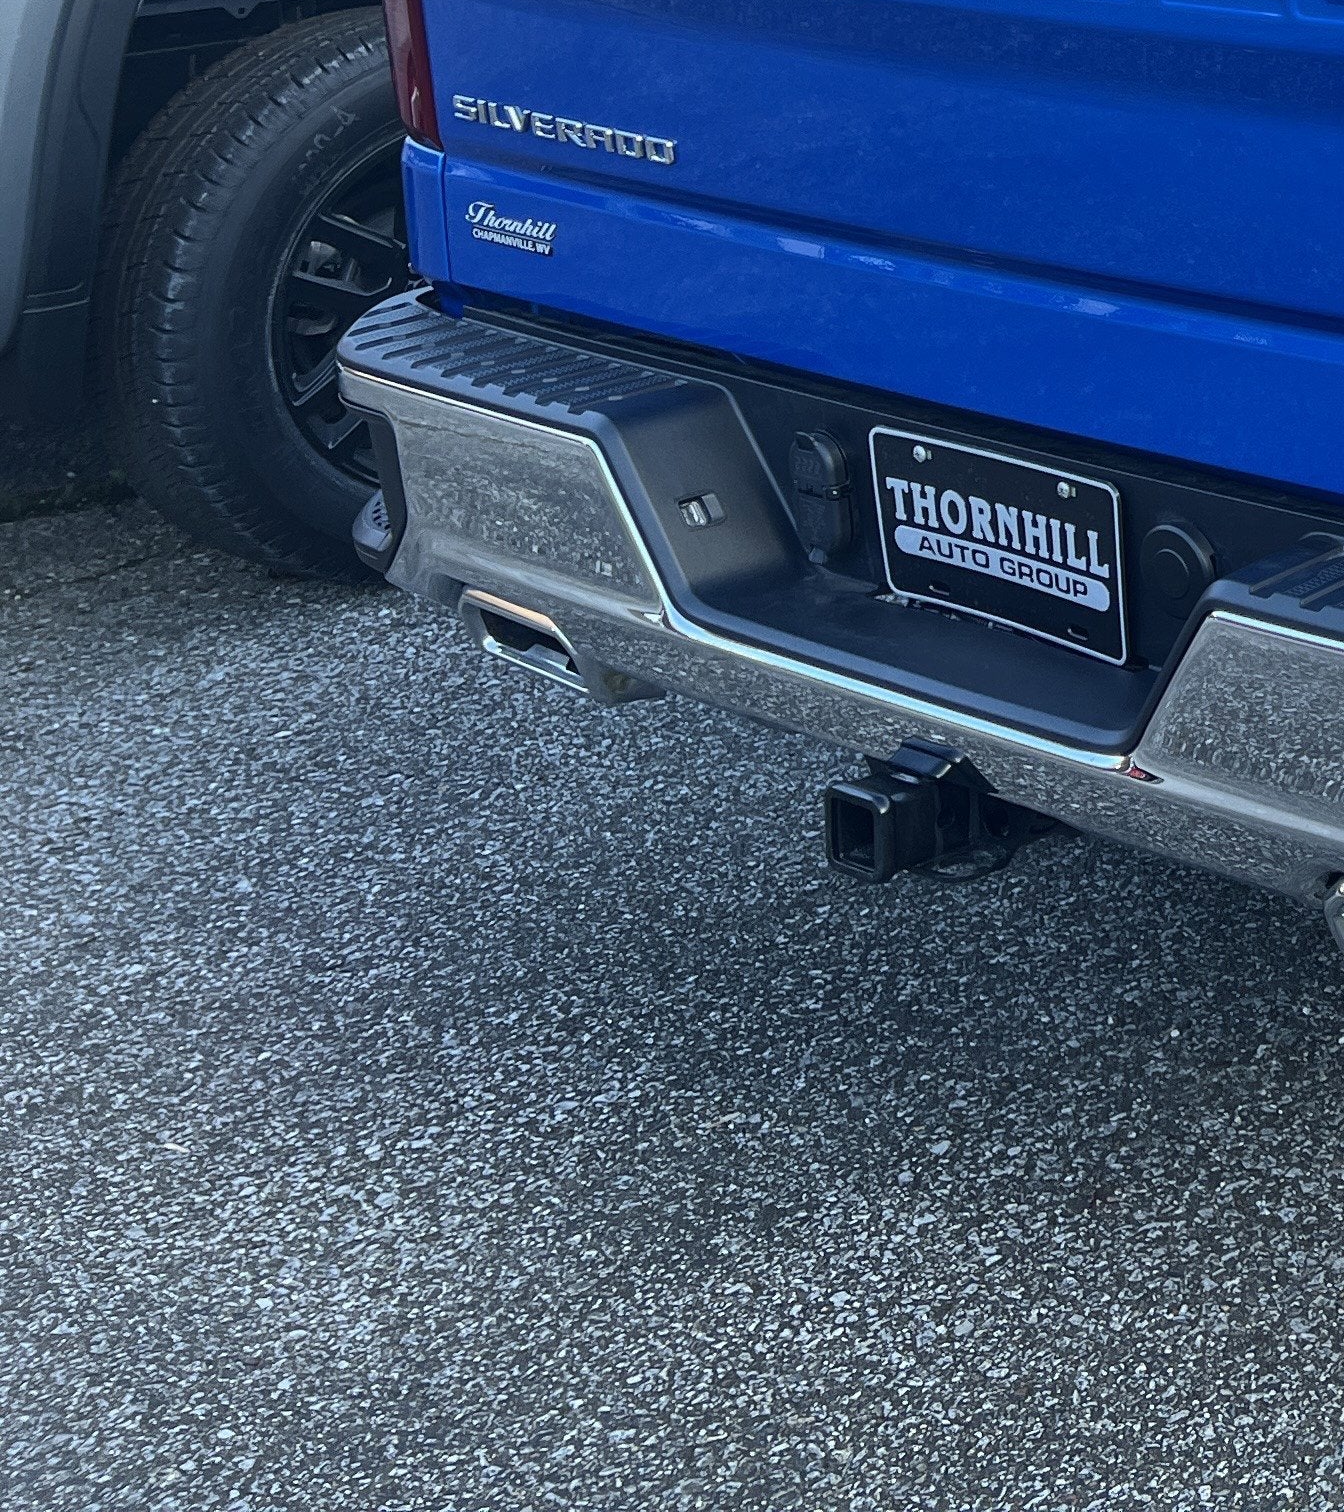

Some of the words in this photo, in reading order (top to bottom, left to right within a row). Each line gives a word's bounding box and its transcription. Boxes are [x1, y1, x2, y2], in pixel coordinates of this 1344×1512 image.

[453, 94, 678, 165] SILVERADO
[465, 201, 557, 241] Thornhill
[535, 242, 552, 255] WV
[885, 476, 1110, 579] THORNHILL
[918, 535, 991, 570] AUTO
[999, 556, 1089, 599] GROUP
